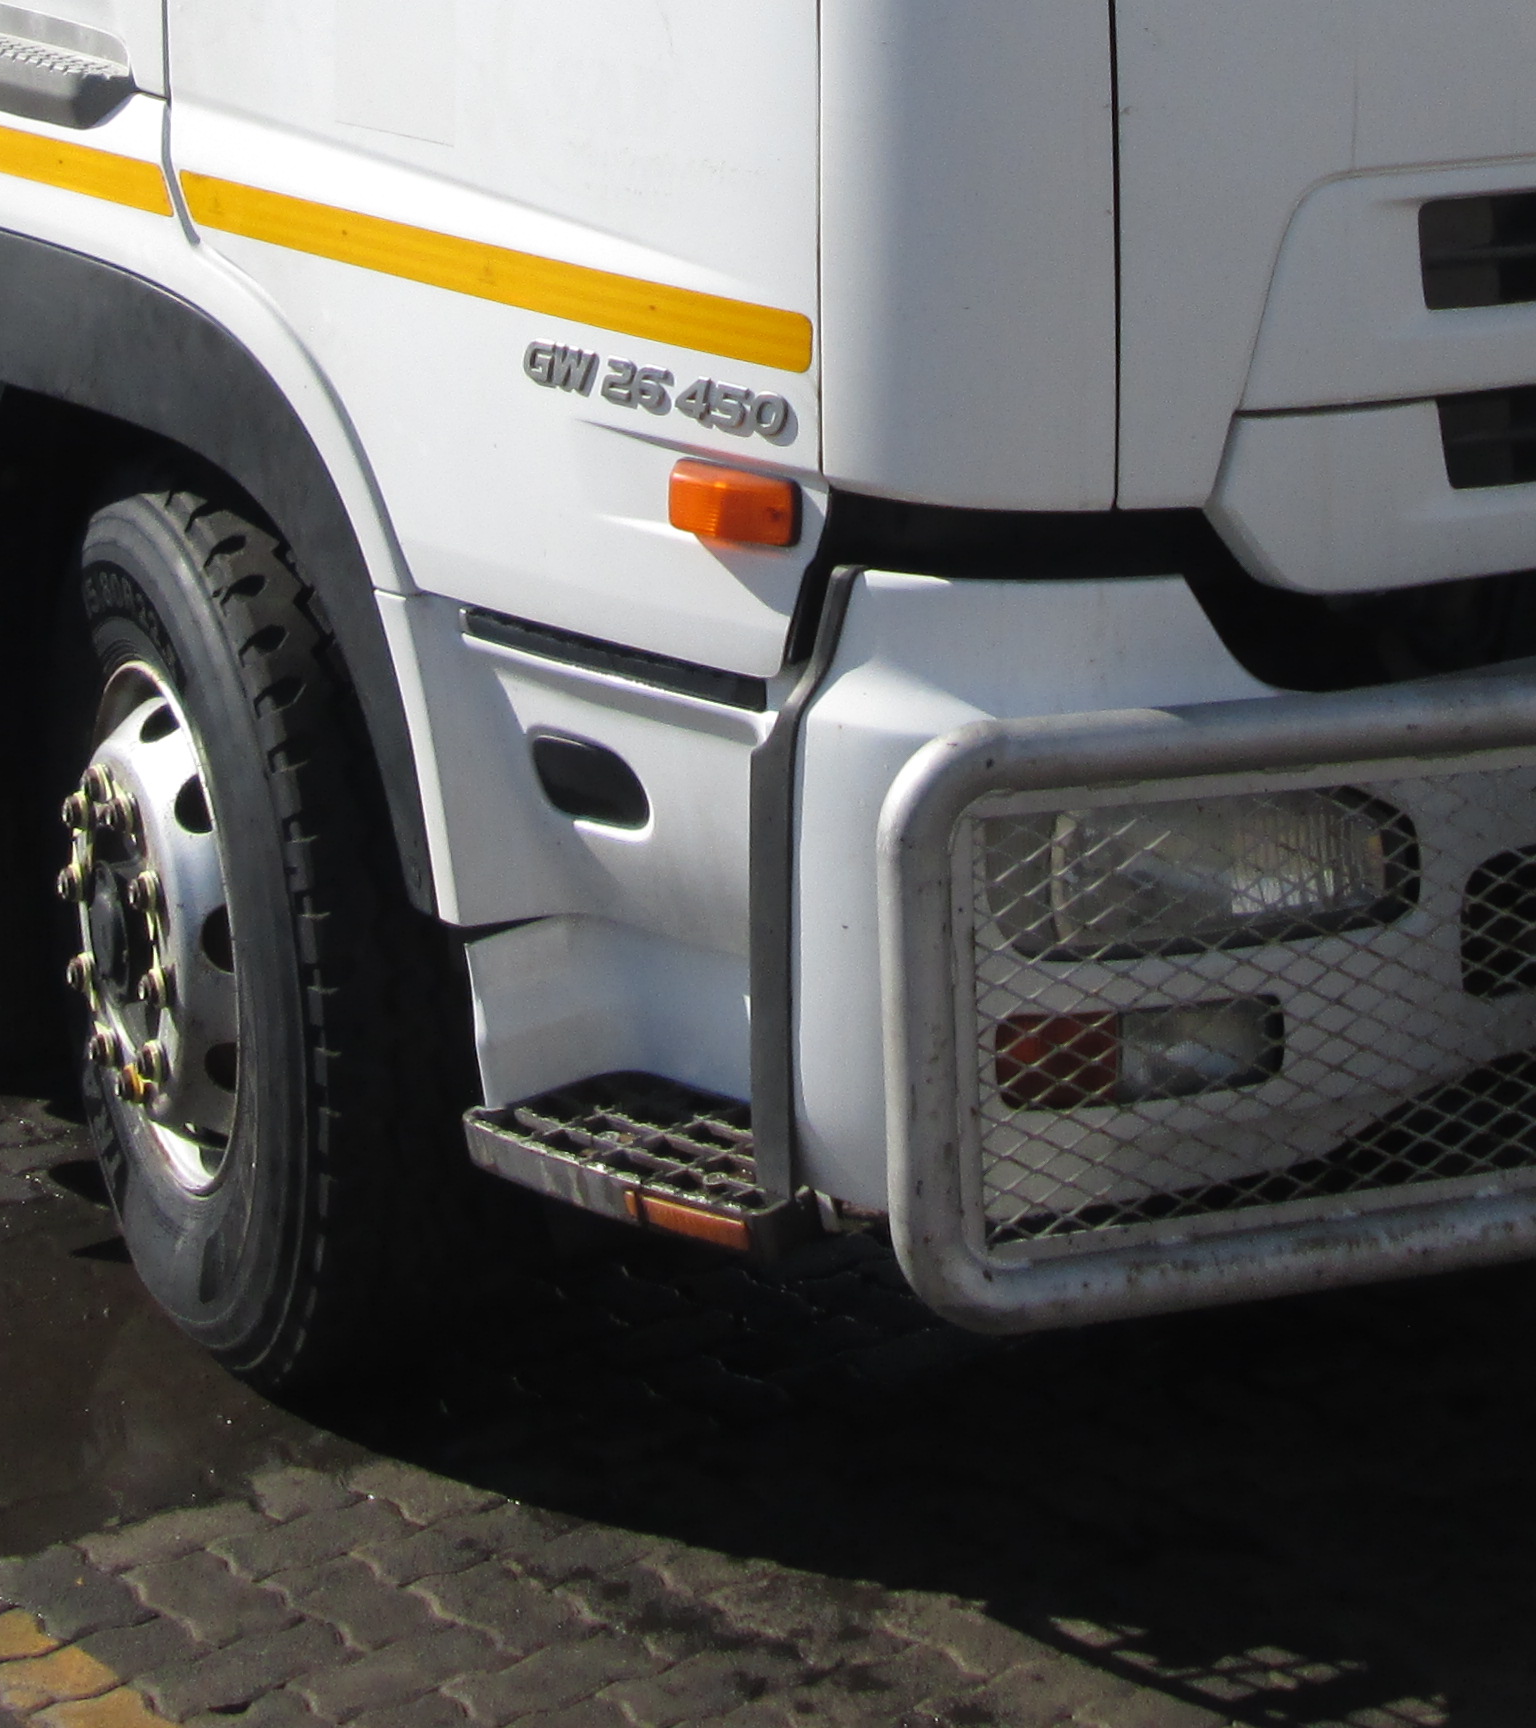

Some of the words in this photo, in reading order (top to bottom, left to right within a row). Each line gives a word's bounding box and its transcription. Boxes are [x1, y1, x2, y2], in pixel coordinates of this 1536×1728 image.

[523, 337, 600, 398] GW
[601, 354, 675, 416] 26
[674, 375, 800, 447] 450
